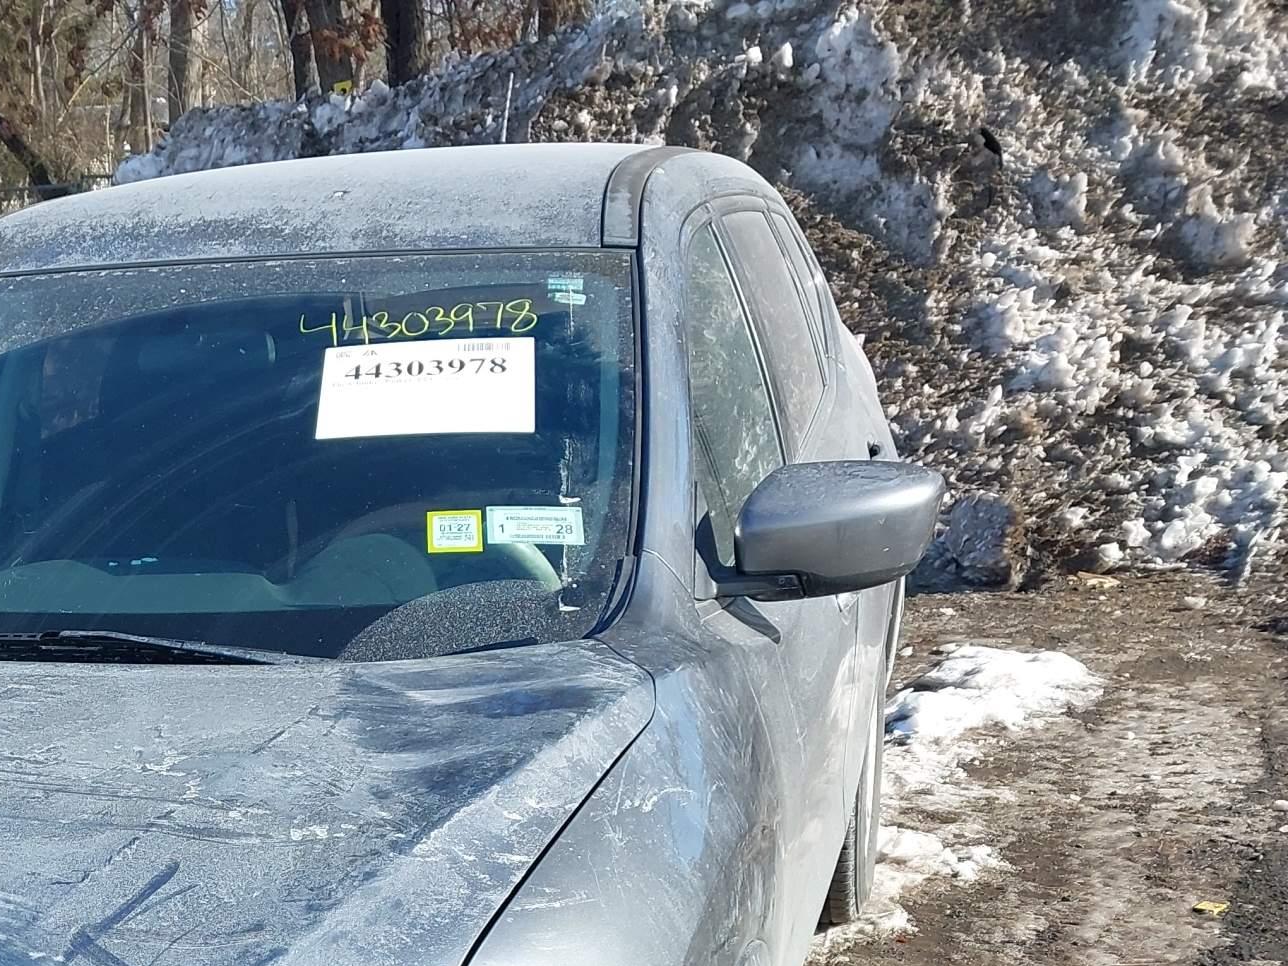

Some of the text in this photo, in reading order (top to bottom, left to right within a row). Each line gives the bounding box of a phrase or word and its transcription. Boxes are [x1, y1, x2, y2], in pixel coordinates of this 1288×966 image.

[300, 298, 538, 347] 44303978
[344, 357, 509, 380] 44303978
[498, 523, 505, 534] 1
[555, 523, 574, 535] 28
